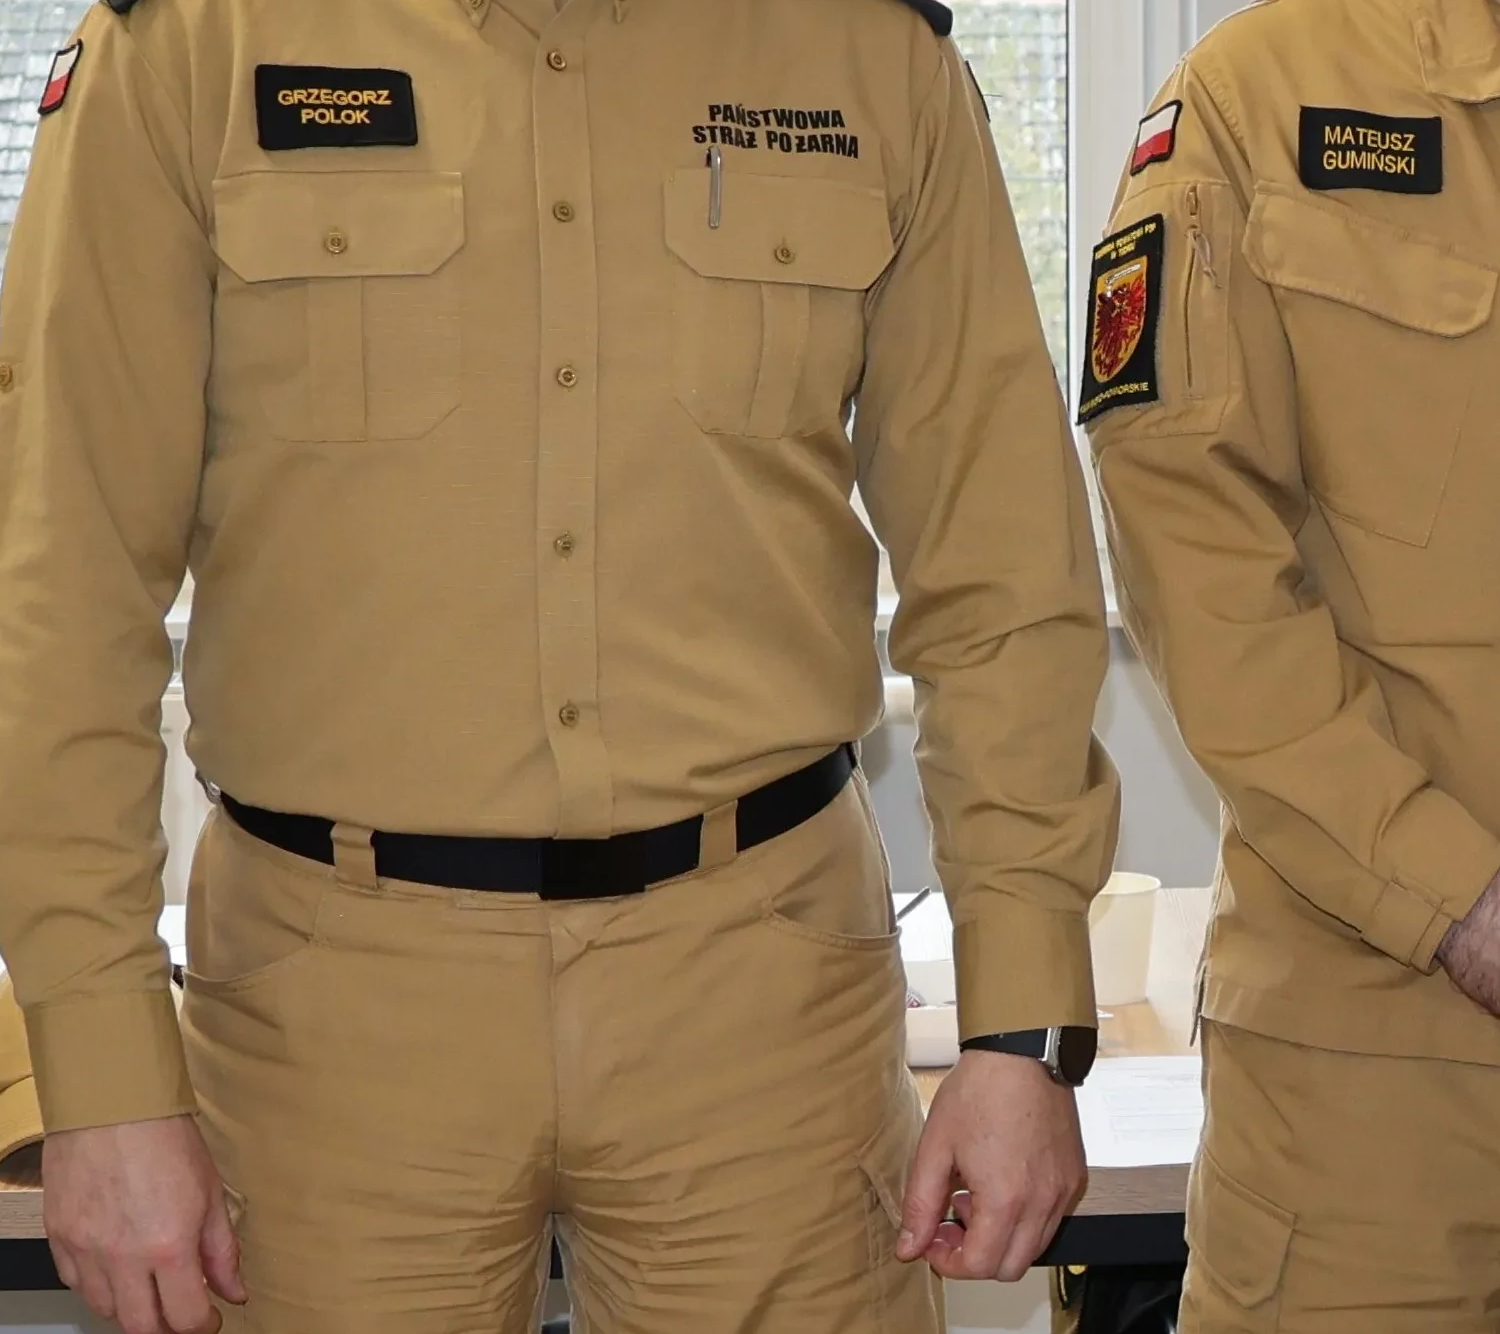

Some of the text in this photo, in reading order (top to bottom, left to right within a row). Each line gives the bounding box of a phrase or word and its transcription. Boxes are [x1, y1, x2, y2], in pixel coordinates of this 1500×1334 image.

[277, 88, 392, 105] GRZEGORZ
[301, 108, 371, 125] POLOK
[708, 103, 846, 130] PAŃSTWOWA
[692, 125, 758, 149] STRAŻ
[1324, 125, 1416, 152] MATEUSZ
[1323, 148, 1415, 175] GUMIŃSKI
